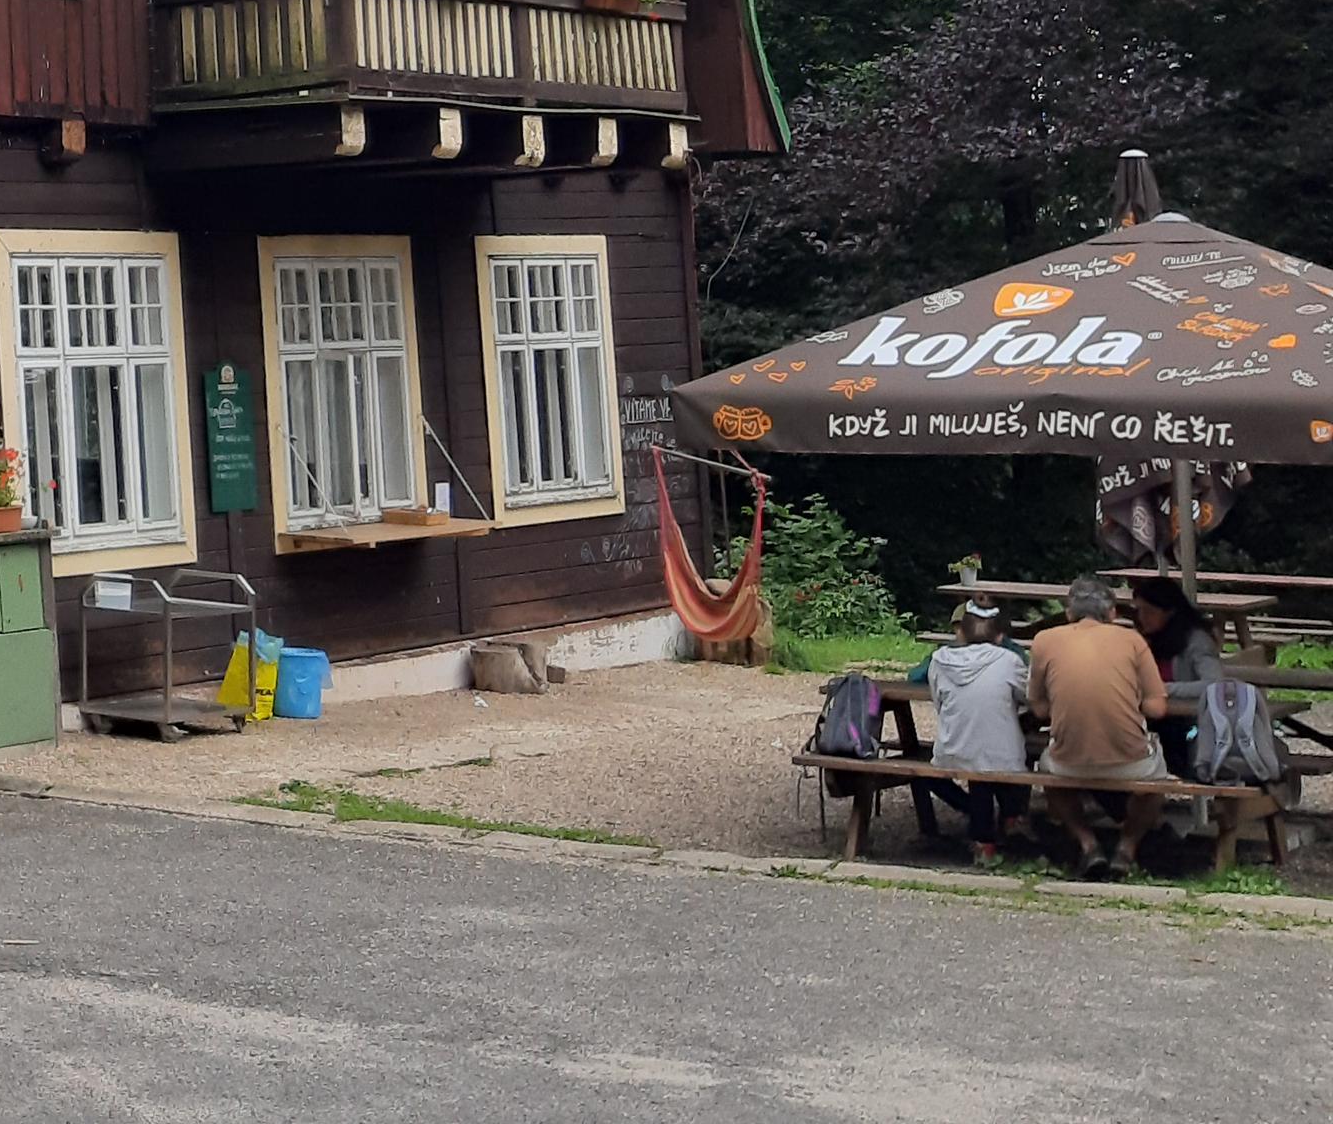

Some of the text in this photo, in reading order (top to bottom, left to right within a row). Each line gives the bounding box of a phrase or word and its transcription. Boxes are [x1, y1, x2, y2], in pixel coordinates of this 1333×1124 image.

[837, 316, 1143, 378] kofola
[973, 357, 1151, 385] original
[828, 401, 1235, 447] KDYŽ JI MILUJEŠ, NENÍ CO ŘEŠIT.
